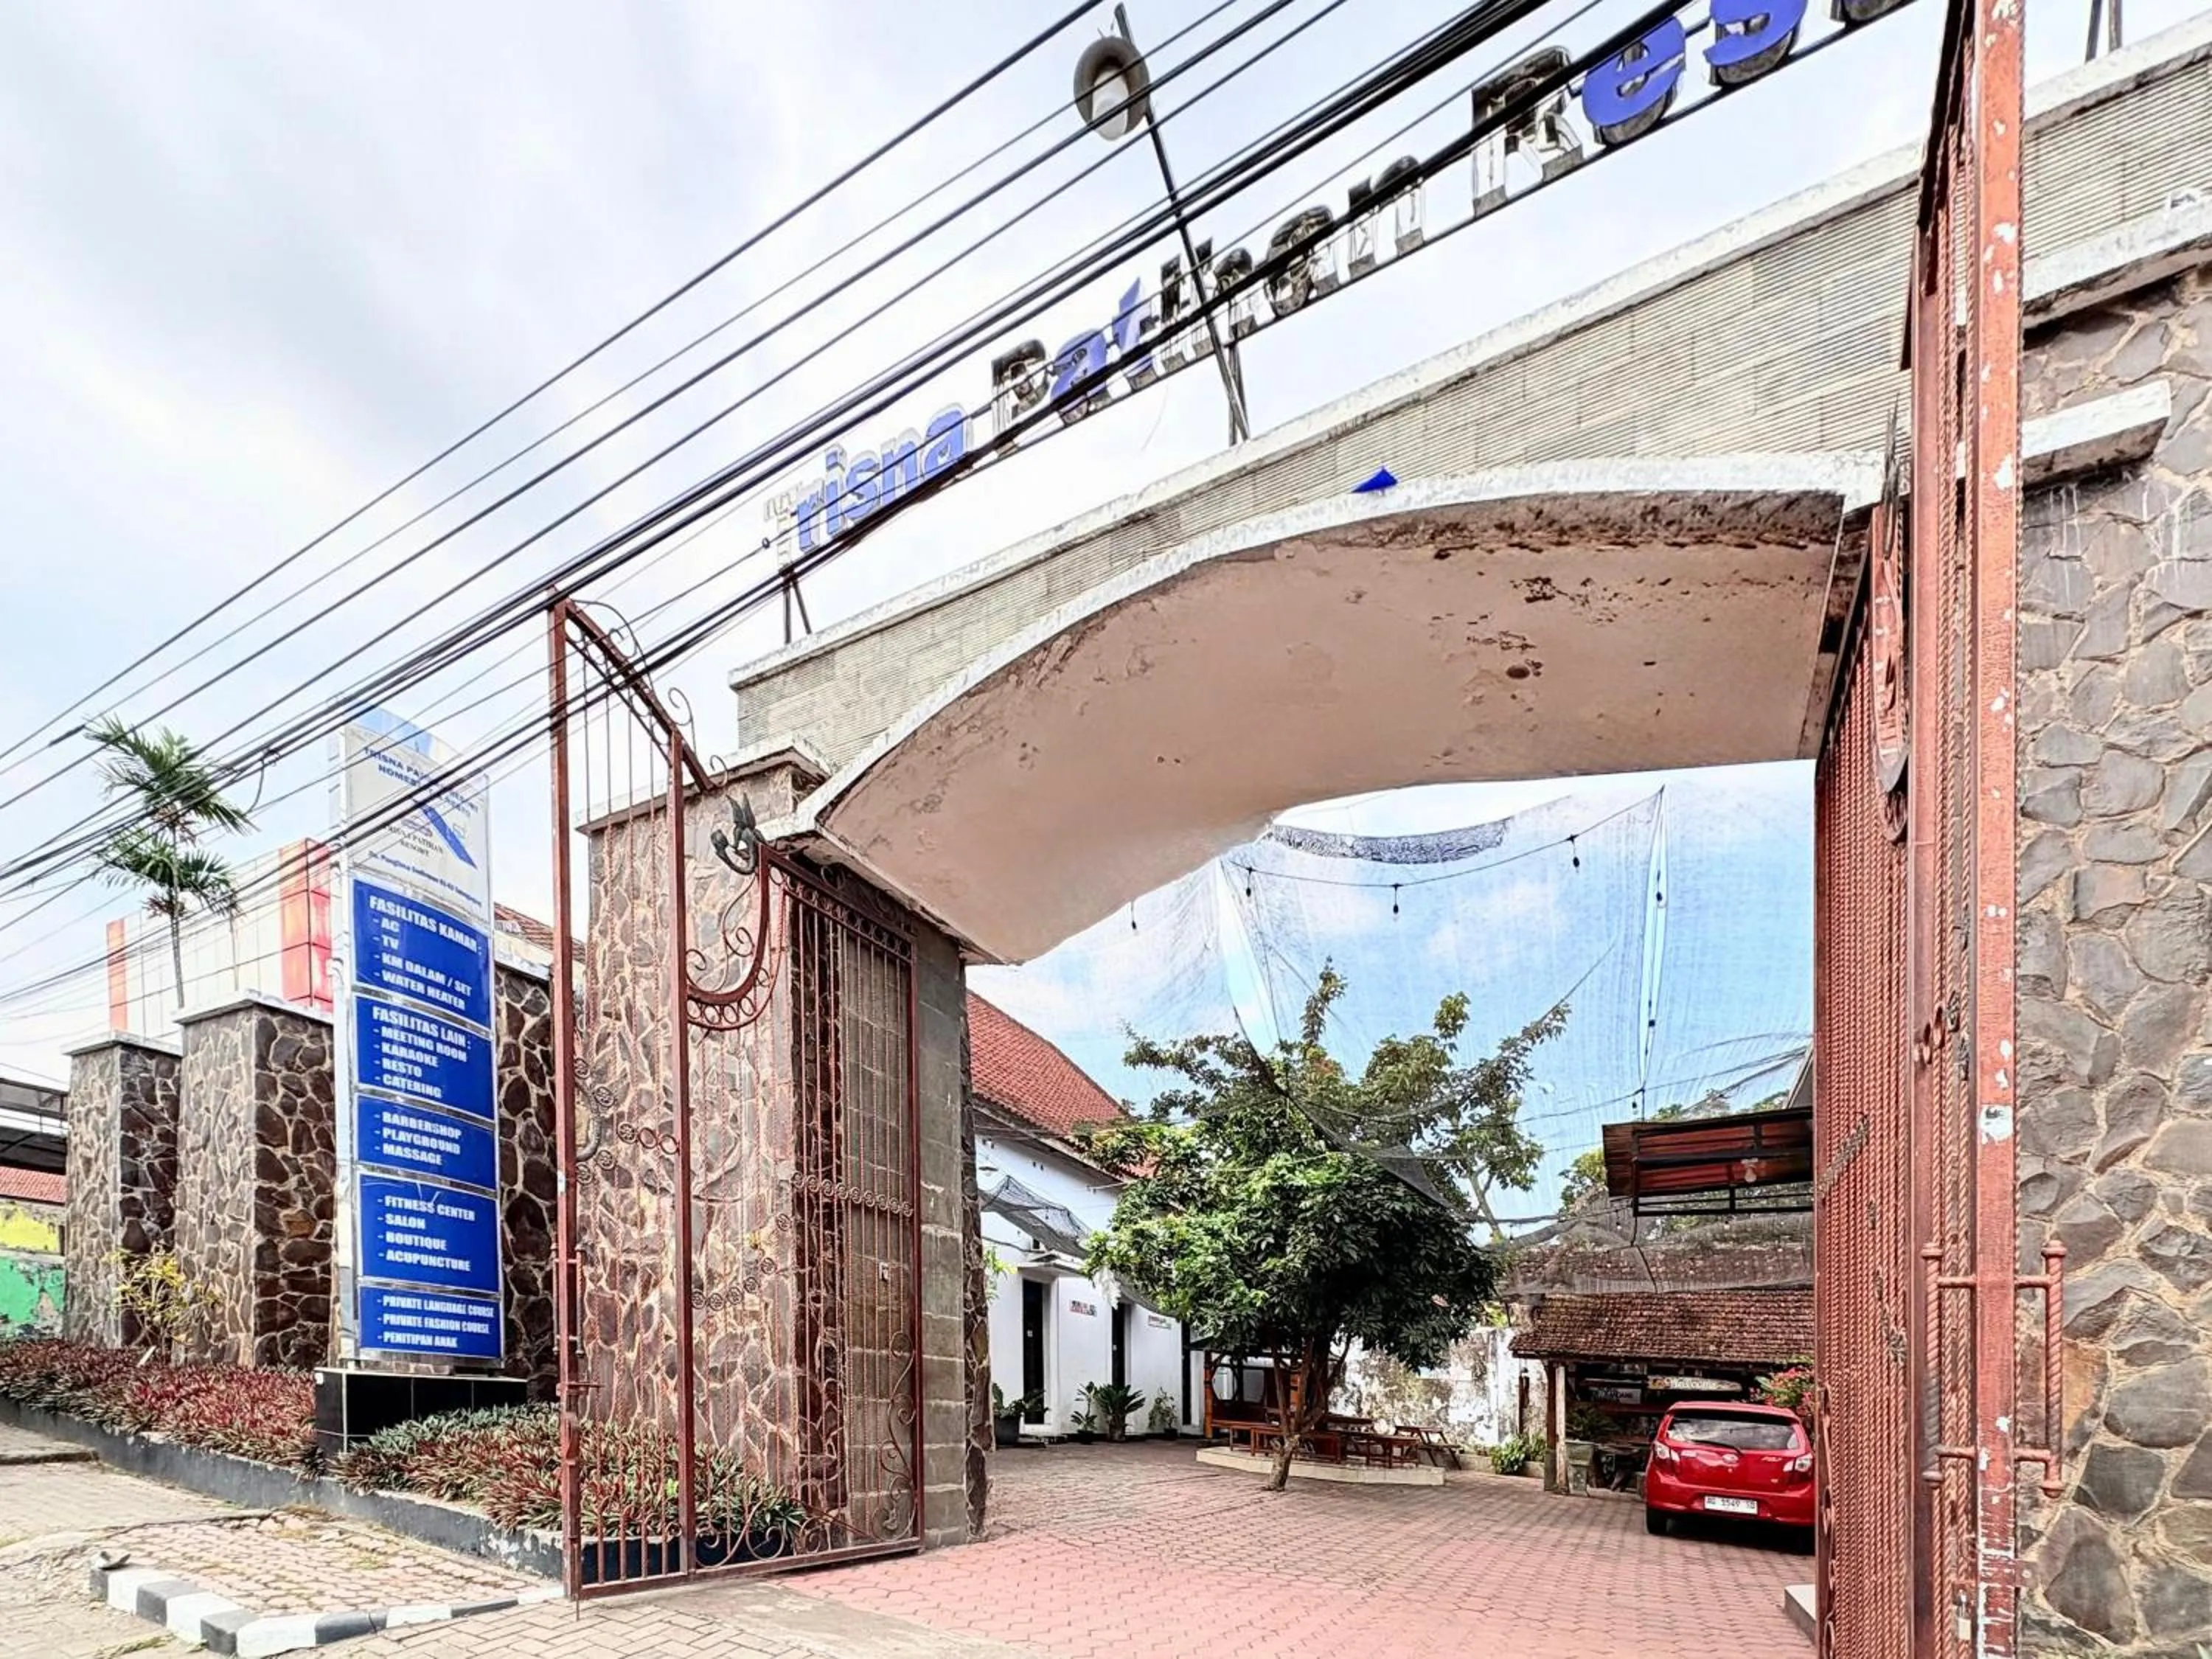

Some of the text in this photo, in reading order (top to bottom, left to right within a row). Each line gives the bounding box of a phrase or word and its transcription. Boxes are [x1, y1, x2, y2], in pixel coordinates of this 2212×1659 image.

[763, 402, 975, 575] Trisna
[369, 895, 437, 933] FASILITAS
[439, 922, 477, 953] KAMAR
[380, 917, 400, 933] AC
[381, 934, 399, 950] TV
[382, 952, 403, 968] KM
[406, 958, 446, 983] DALAM
[454, 979, 472, 996] SET
[383, 970, 425, 994] WATER
[427, 985, 466, 1011] HEATER
[372, 1006, 439, 1037] FASILITAS
[440, 1026, 466, 1048] LAIN
[381, 1026, 434, 1051] MEETING
[436, 1041, 467, 1062] ROOM
[382, 1042, 438, 1068] KARAOKE
[383, 1057, 422, 1078] RESTO
[383, 1074, 442, 1098] CATERING
[382, 1111, 462, 1139] BARBERSHOP
[383, 1127, 461, 1155] PLAYGROUND
[383, 1144, 442, 1166] MASSAGE
[385, 1194, 435, 1213] FITNESS
[437, 1203, 476, 1222] CENTER
[386, 1213, 426, 1230] SALON
[386, 1231, 447, 1251] BOUTIQUE
[386, 1249, 471, 1272] ACUPUNCTURE
[383, 1295, 422, 1310] PRIVATE
[424, 1299, 466, 1315] LANGUAGE
[467, 1305, 494, 1318] COURSE
[383, 1313, 422, 1328] PRIVATE
[424, 1317, 460, 1332] FASHION
[462, 1321, 490, 1335] COURSE
[383, 1331, 432, 1346] PENITIPAN
[434, 1334, 458, 1349] ANAK
